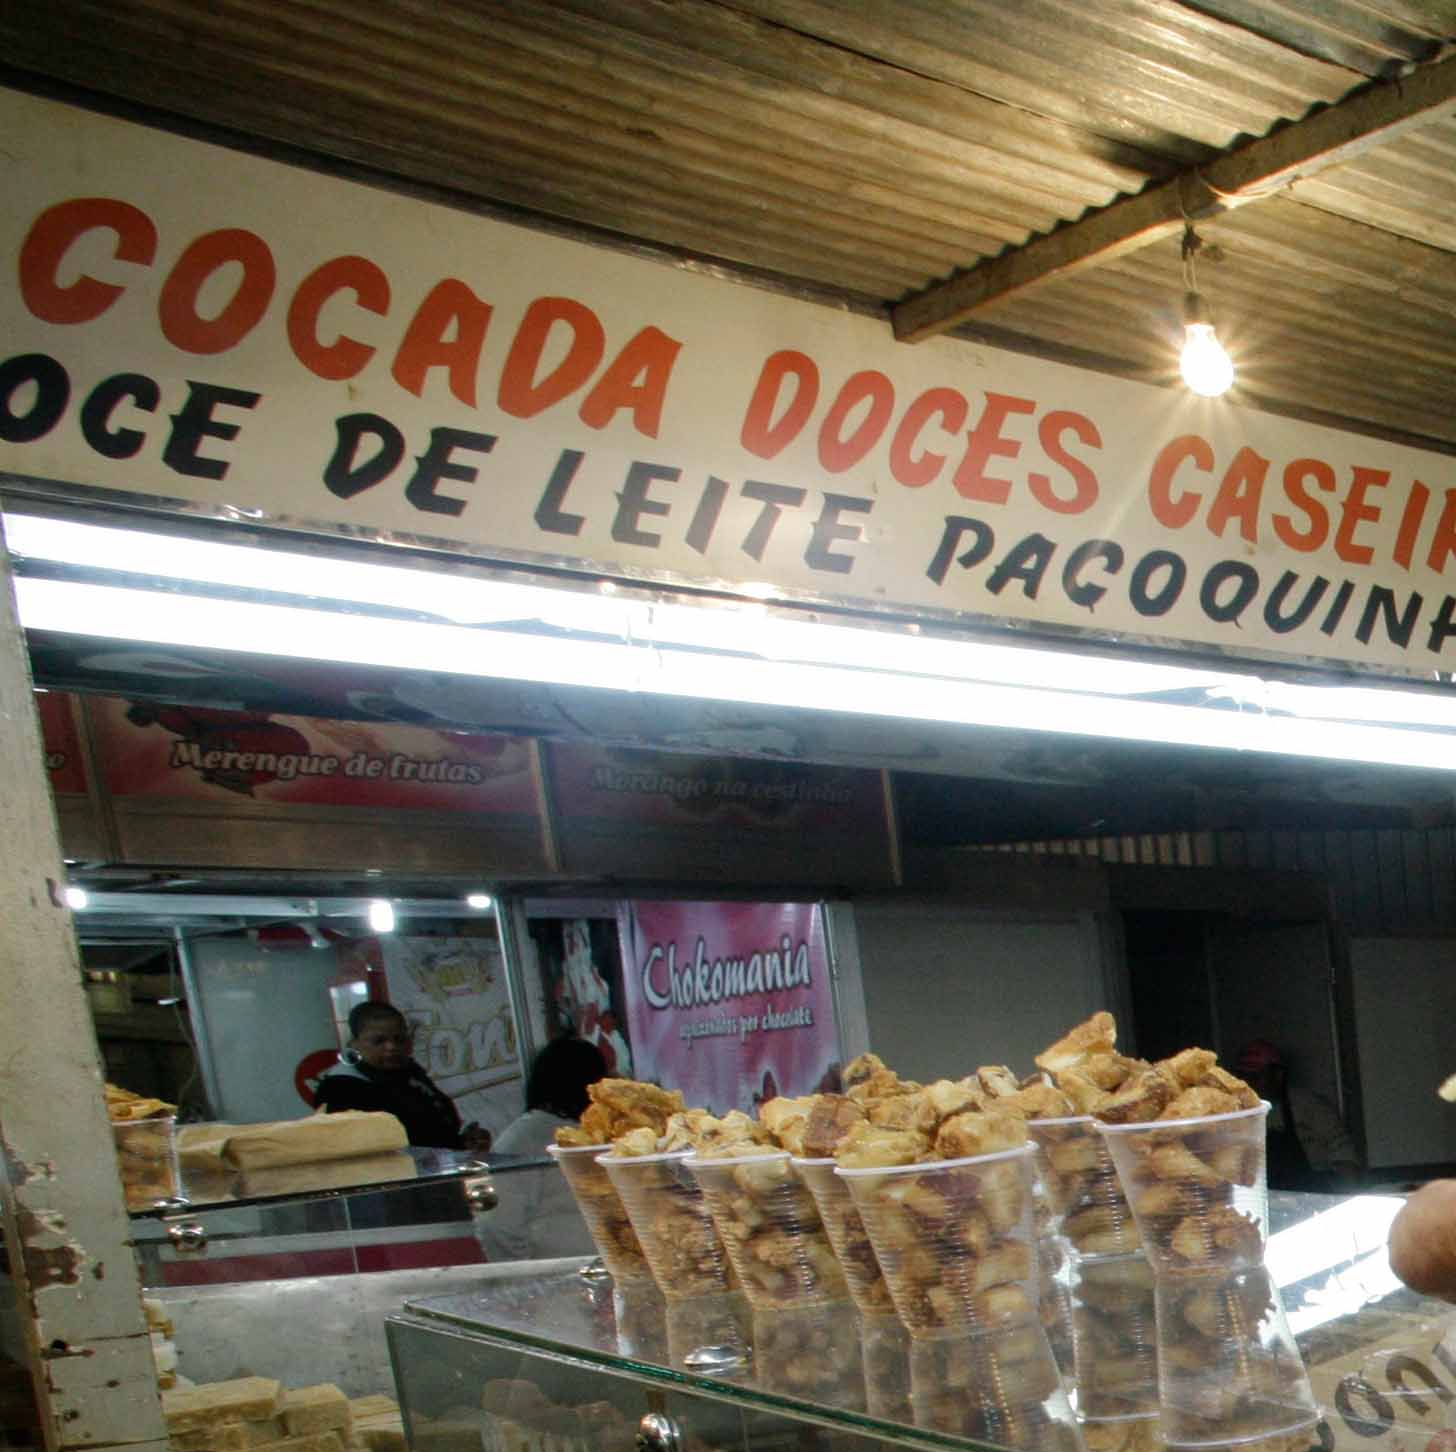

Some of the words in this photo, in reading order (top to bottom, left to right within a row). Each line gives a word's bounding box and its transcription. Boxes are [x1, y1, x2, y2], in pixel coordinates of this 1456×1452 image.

[19, 196, 683, 438] COCADA
[740, 349, 1103, 515] DOCES
[0, 353, 263, 481] OCE
[323, 412, 498, 518] DE
[533, 448, 874, 575] LEITE
[171, 740, 338, 780] Merengue
[345, 748, 384, 778] de
[389, 753, 485, 785] frutas
[642, 934, 810, 1010] Chokomania
